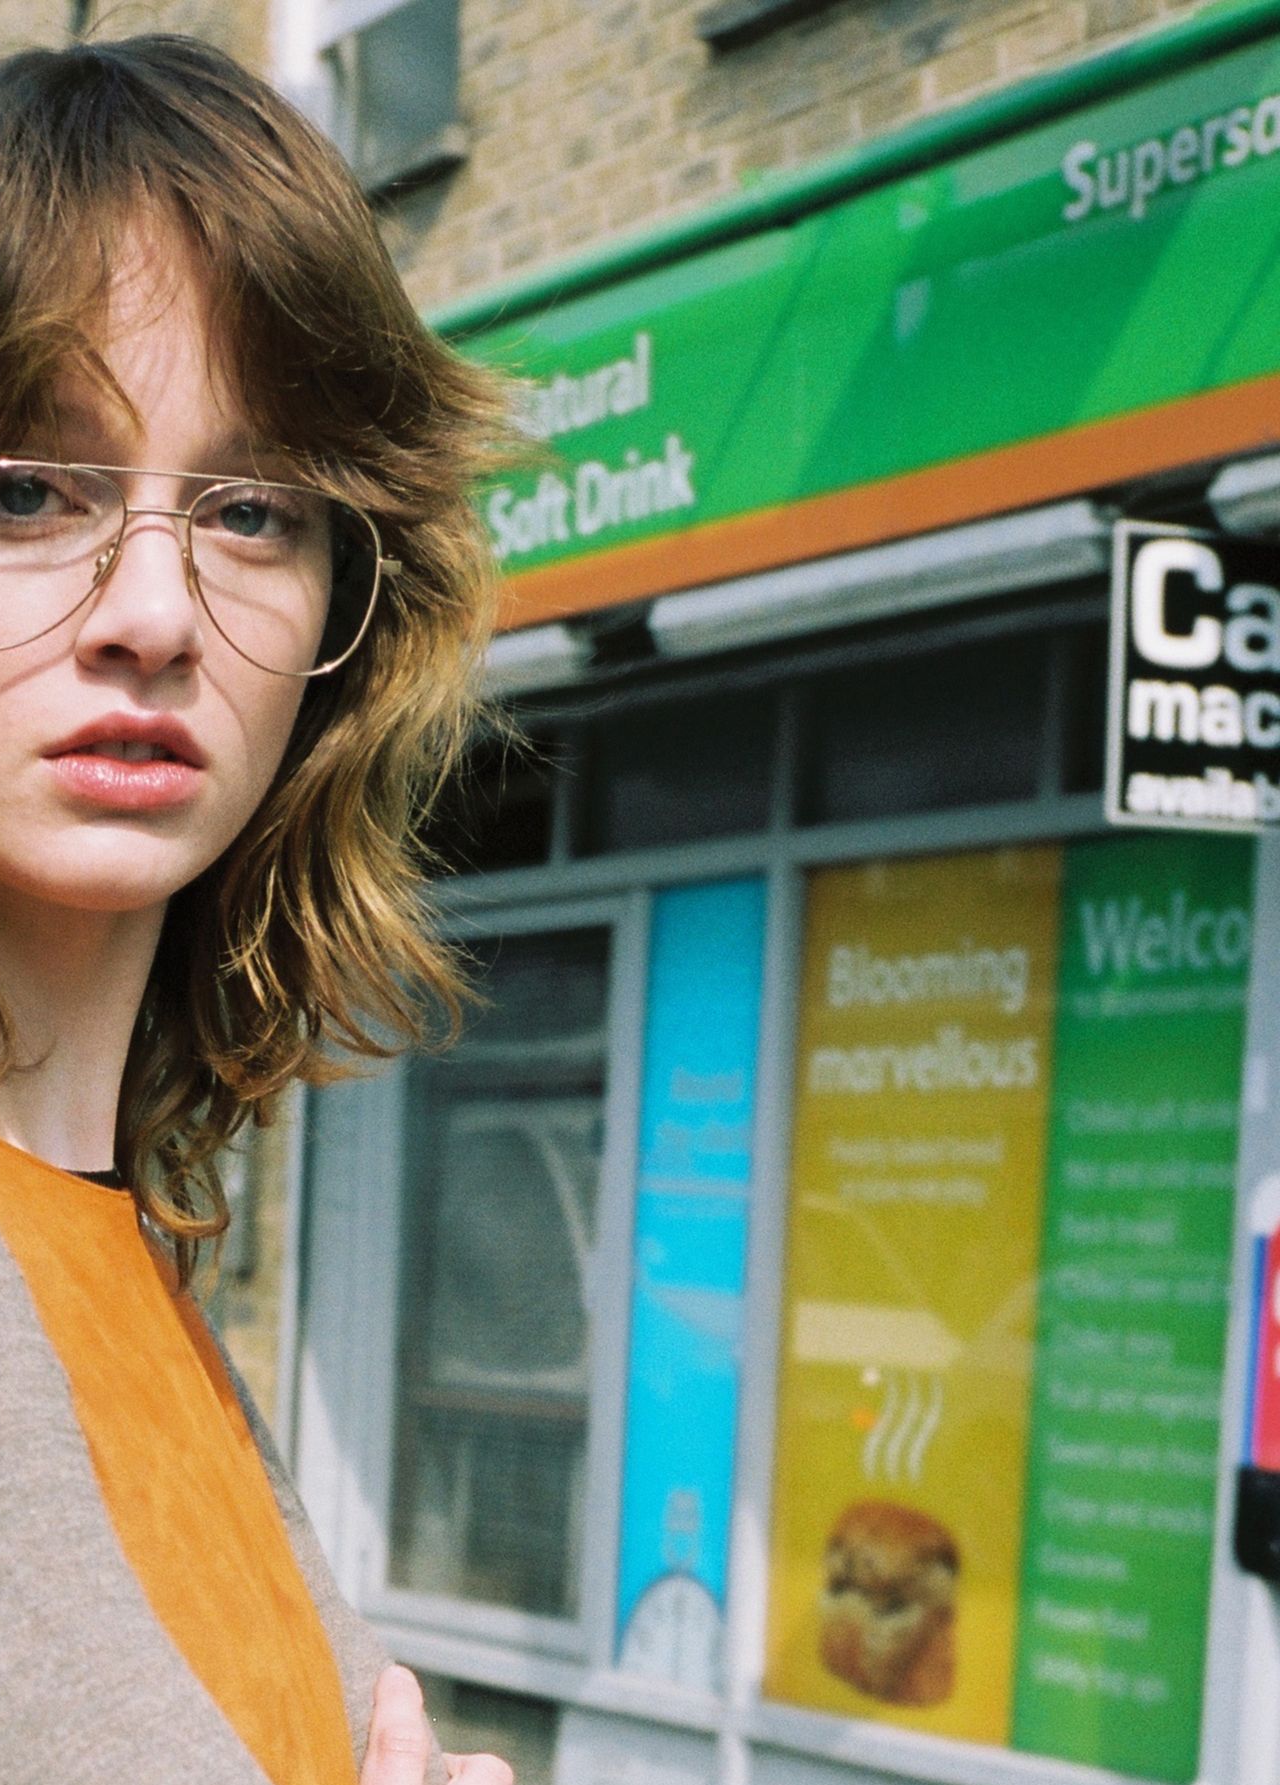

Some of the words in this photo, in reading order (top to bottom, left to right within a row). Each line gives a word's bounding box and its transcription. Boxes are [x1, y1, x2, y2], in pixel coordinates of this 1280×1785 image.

[489, 472, 570, 558] Soft
[575, 435, 694, 535] Drink
[1132, 538, 1280, 671] Ca
[1128, 679, 1280, 747] mac
[1081, 891, 1250, 974] Welco
[828, 936, 1029, 1014] Blooming
